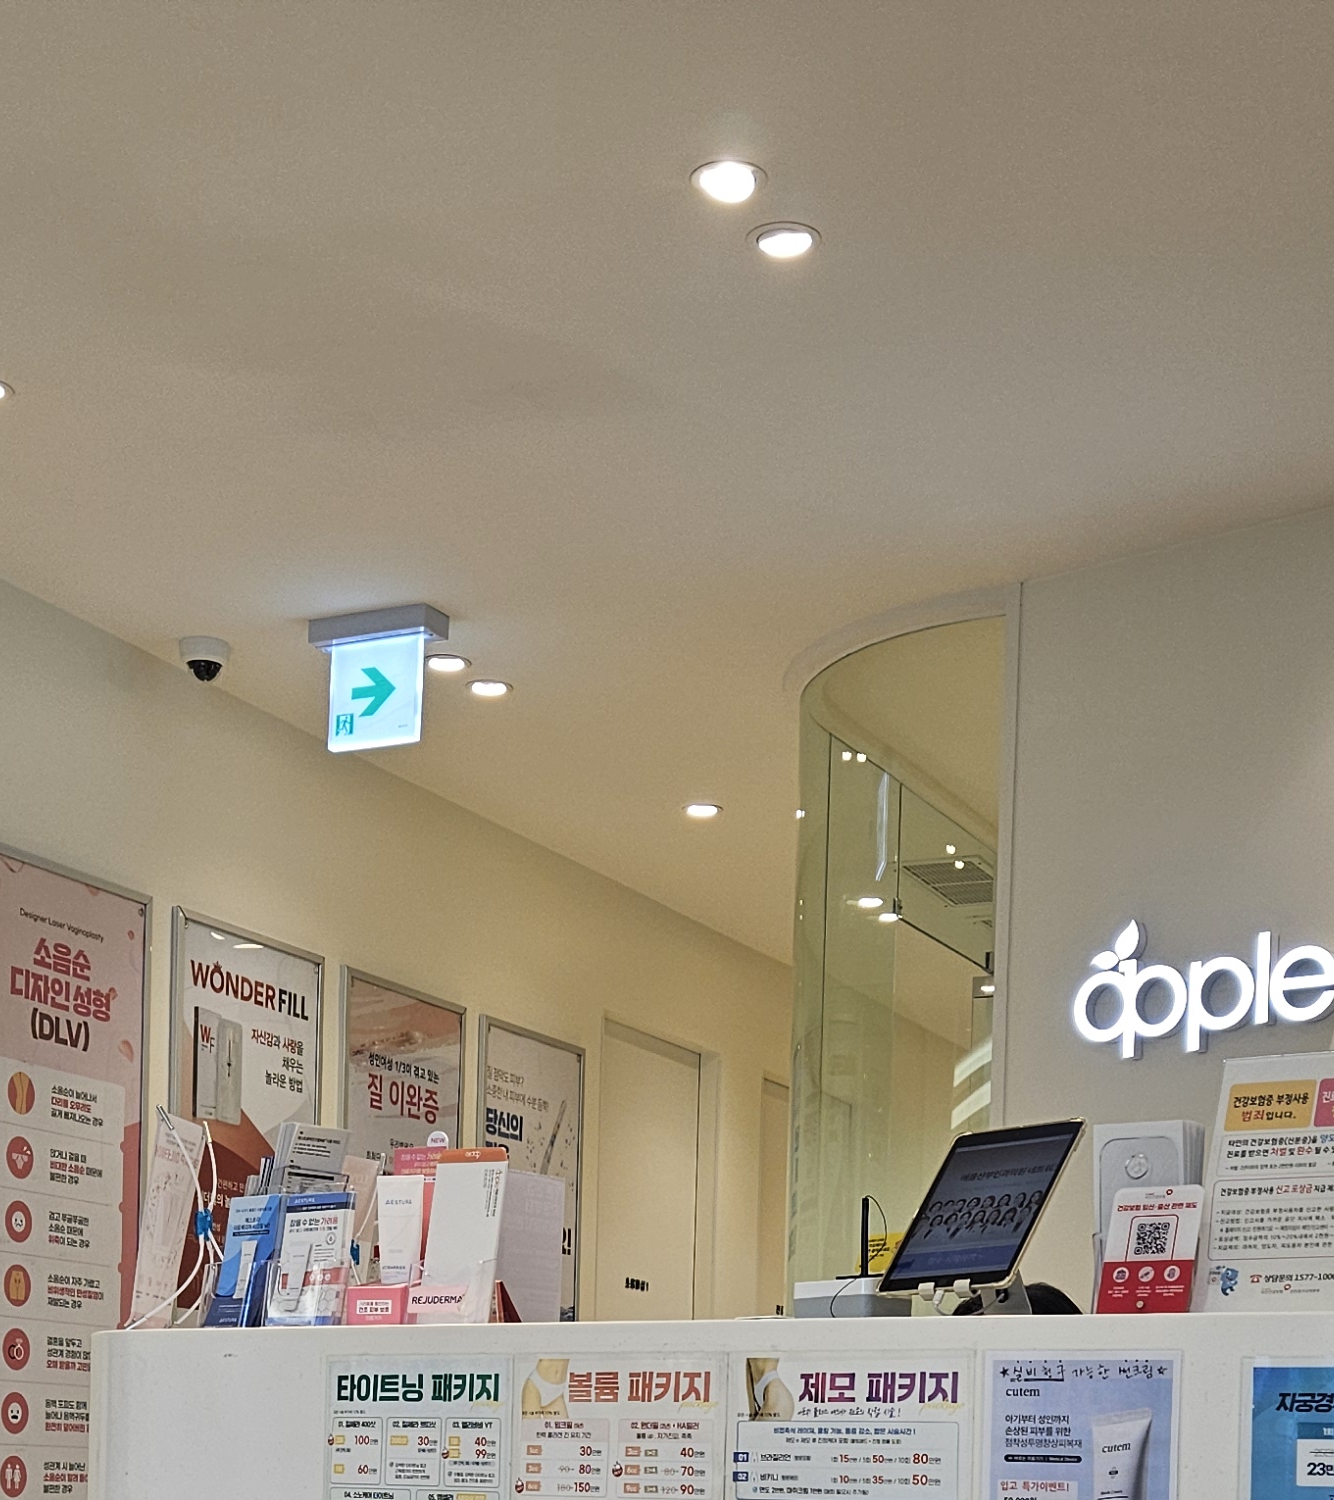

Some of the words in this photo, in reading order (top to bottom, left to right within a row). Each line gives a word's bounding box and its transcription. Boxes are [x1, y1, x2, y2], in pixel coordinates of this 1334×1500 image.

[20, 907, 47, 923] Designer
[48, 917, 65, 929] Laser
[67, 923, 104, 943] Vaginoplasty
[33, 937, 91, 982] 소음순
[10, 966, 70, 1012] 디자인
[73, 985, 111, 1022] 성형
[31, 1007, 90, 1052] (DLV)
[251, 1029, 280, 1049] 자신감과
[283, 1037, 304, 1056] 사랑을
[282, 1056, 304, 1075] 채우는
[368, 1051, 393, 1072] 성인여성
[395, 1061, 412, 1077] 1/3이
[414, 1065, 426, 1080] 겪고
[427, 1069, 440, 1085] 있는
[265, 1069, 287, 1089] 놀라운
[289, 1076, 303, 1093] 방법
[367, 1072, 383, 1111] 질
[389, 1080, 440, 1125] 이완증
[1233, 1094, 1274, 1108] 건강보험증
[1276, 1092, 1310, 1105] 부정사용
[486, 1107, 524, 1141] 당신의
[1241, 1110, 1297, 1122] 범죄입니다.
[431, 1136, 446, 1144] NEW
[1264, 1274, 1293, 1283] 상담문의
[1072, 1365, 1110, 1380] 가능한
[337, 1374, 424, 1402] 타이트닝
[431, 1373, 500, 1402] 패키지
[568, 1372, 619, 1403] 볼륨
[628, 1371, 711, 1403] 패키지
[798, 1372, 856, 1403] 제모
[866, 1371, 959, 1404] 패키지
[1005, 1387, 1040, 1397] cutem
[1005, 1415, 1036, 1425] 아기부터
[1038, 1415, 1069, 1425] 성인까지
[1102, 1442, 1131, 1454] cutem
[1000, 1481, 1018, 1491] 입고
[1022, 1481, 1070, 1492] 특가이벤트!
